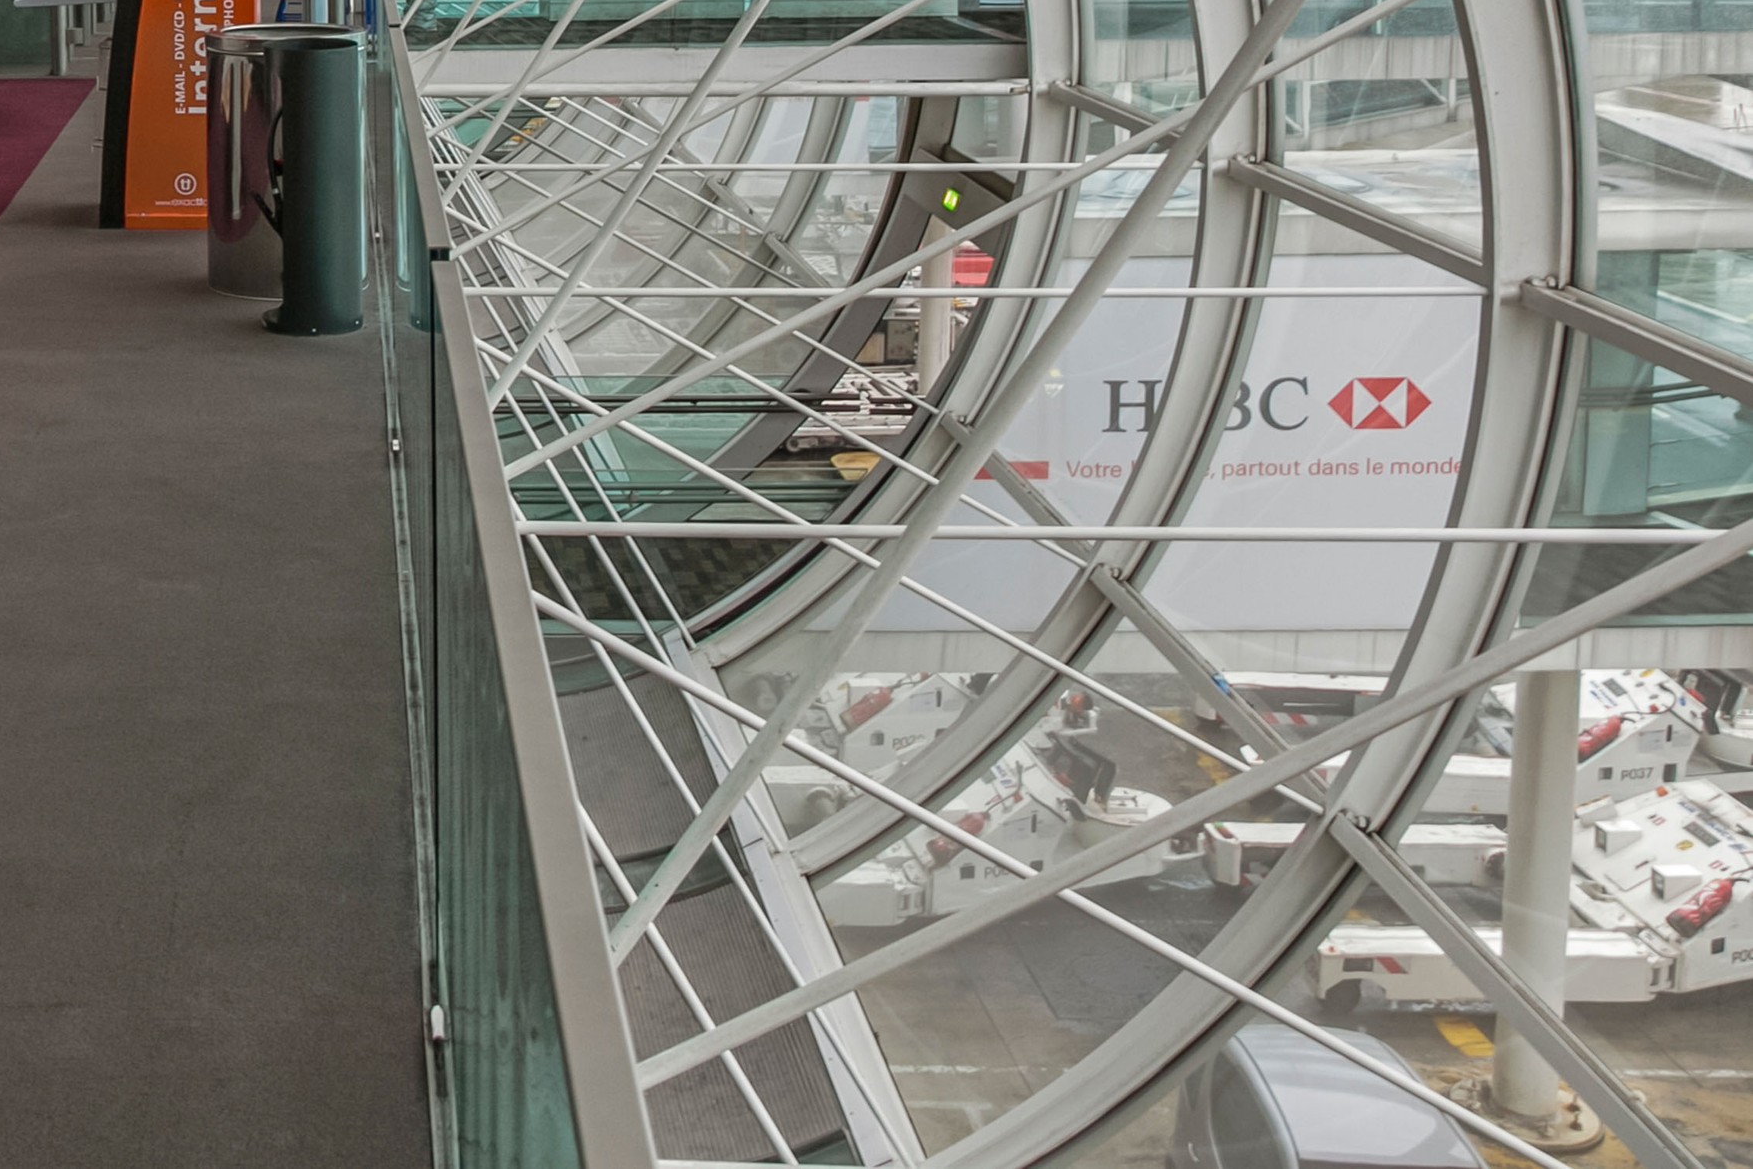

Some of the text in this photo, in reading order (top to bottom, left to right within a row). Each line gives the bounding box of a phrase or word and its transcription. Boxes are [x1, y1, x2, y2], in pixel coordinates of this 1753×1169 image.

[174, 11, 185, 60] DVD/CD
[174, 71, 186, 114] E-MAIL
[1066, 461, 1122, 478] Votre
[1222, 460, 1301, 480] partout
[1308, 458, 1360, 476] dans
[1366, 457, 1384, 475] le
[1390, 457, 1462, 475] monde
